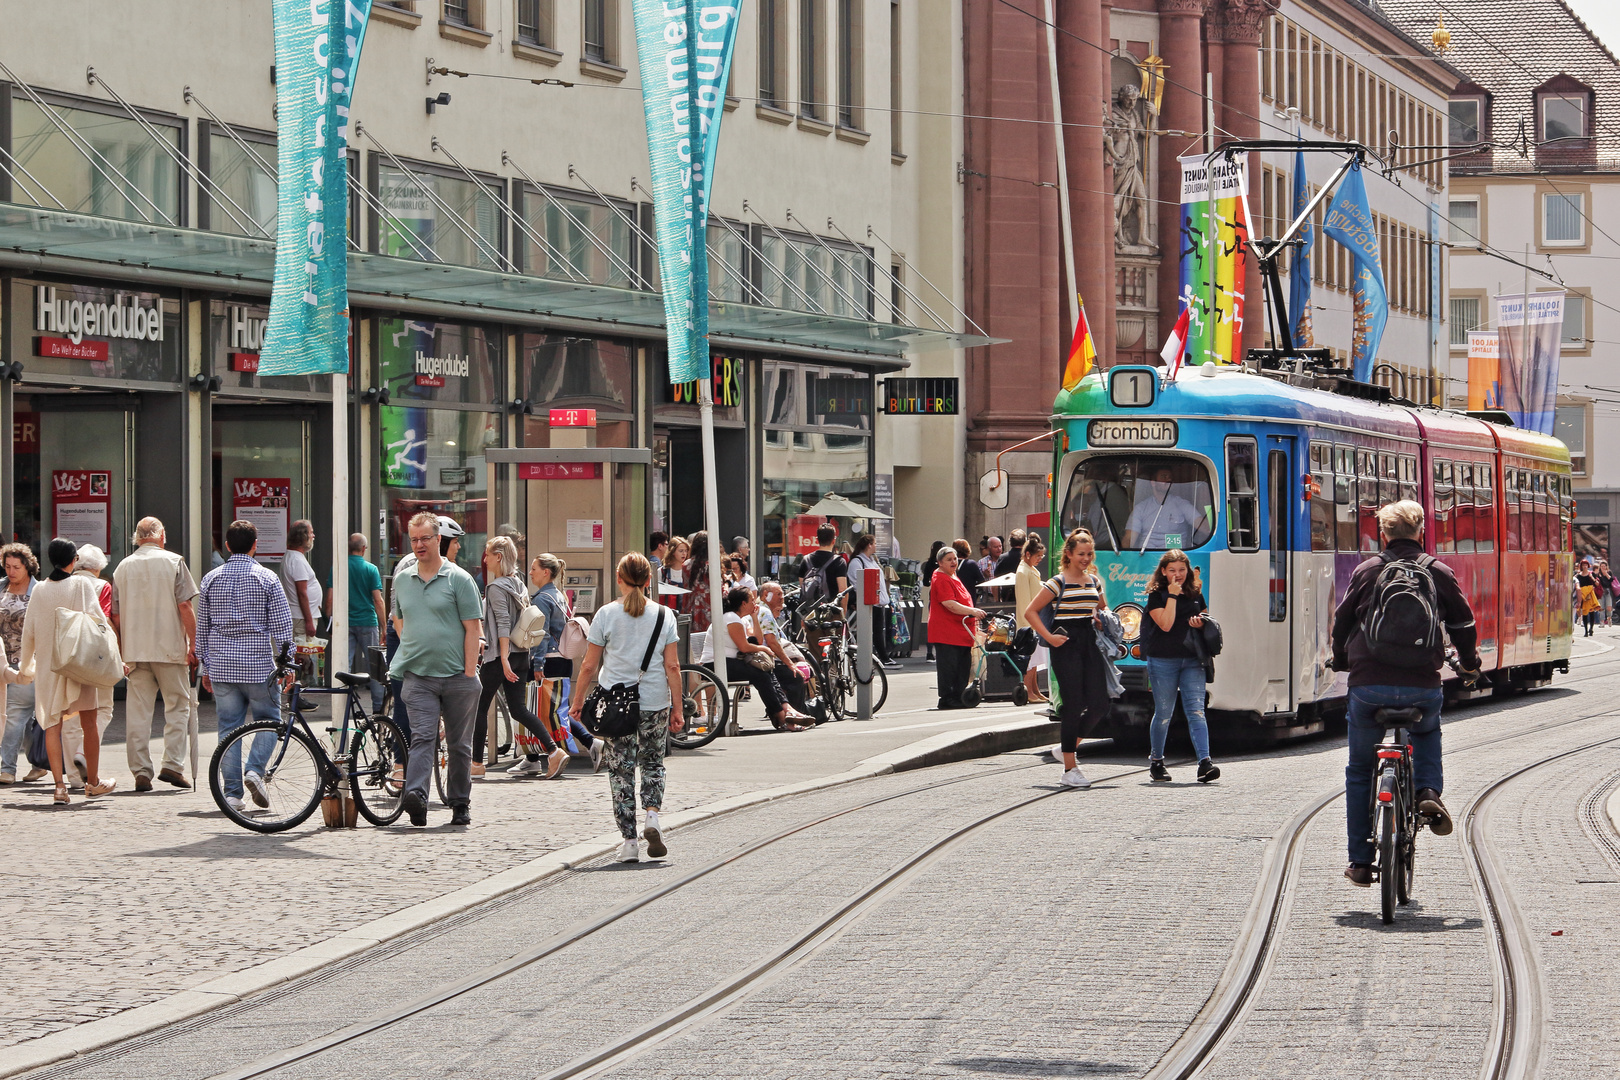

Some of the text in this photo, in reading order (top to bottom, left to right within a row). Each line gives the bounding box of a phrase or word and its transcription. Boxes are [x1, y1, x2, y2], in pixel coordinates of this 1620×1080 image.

[37, 285, 164, 345] Hugendubel
[51, 343, 60, 354] Die
[61, 344, 72, 355] Welt
[415, 350, 469, 379] Hugendubel
[1129, 375, 1138, 403] 1
[890, 398, 953, 412] BUTLERS
[1166, 537, 1181, 545] 2-15
